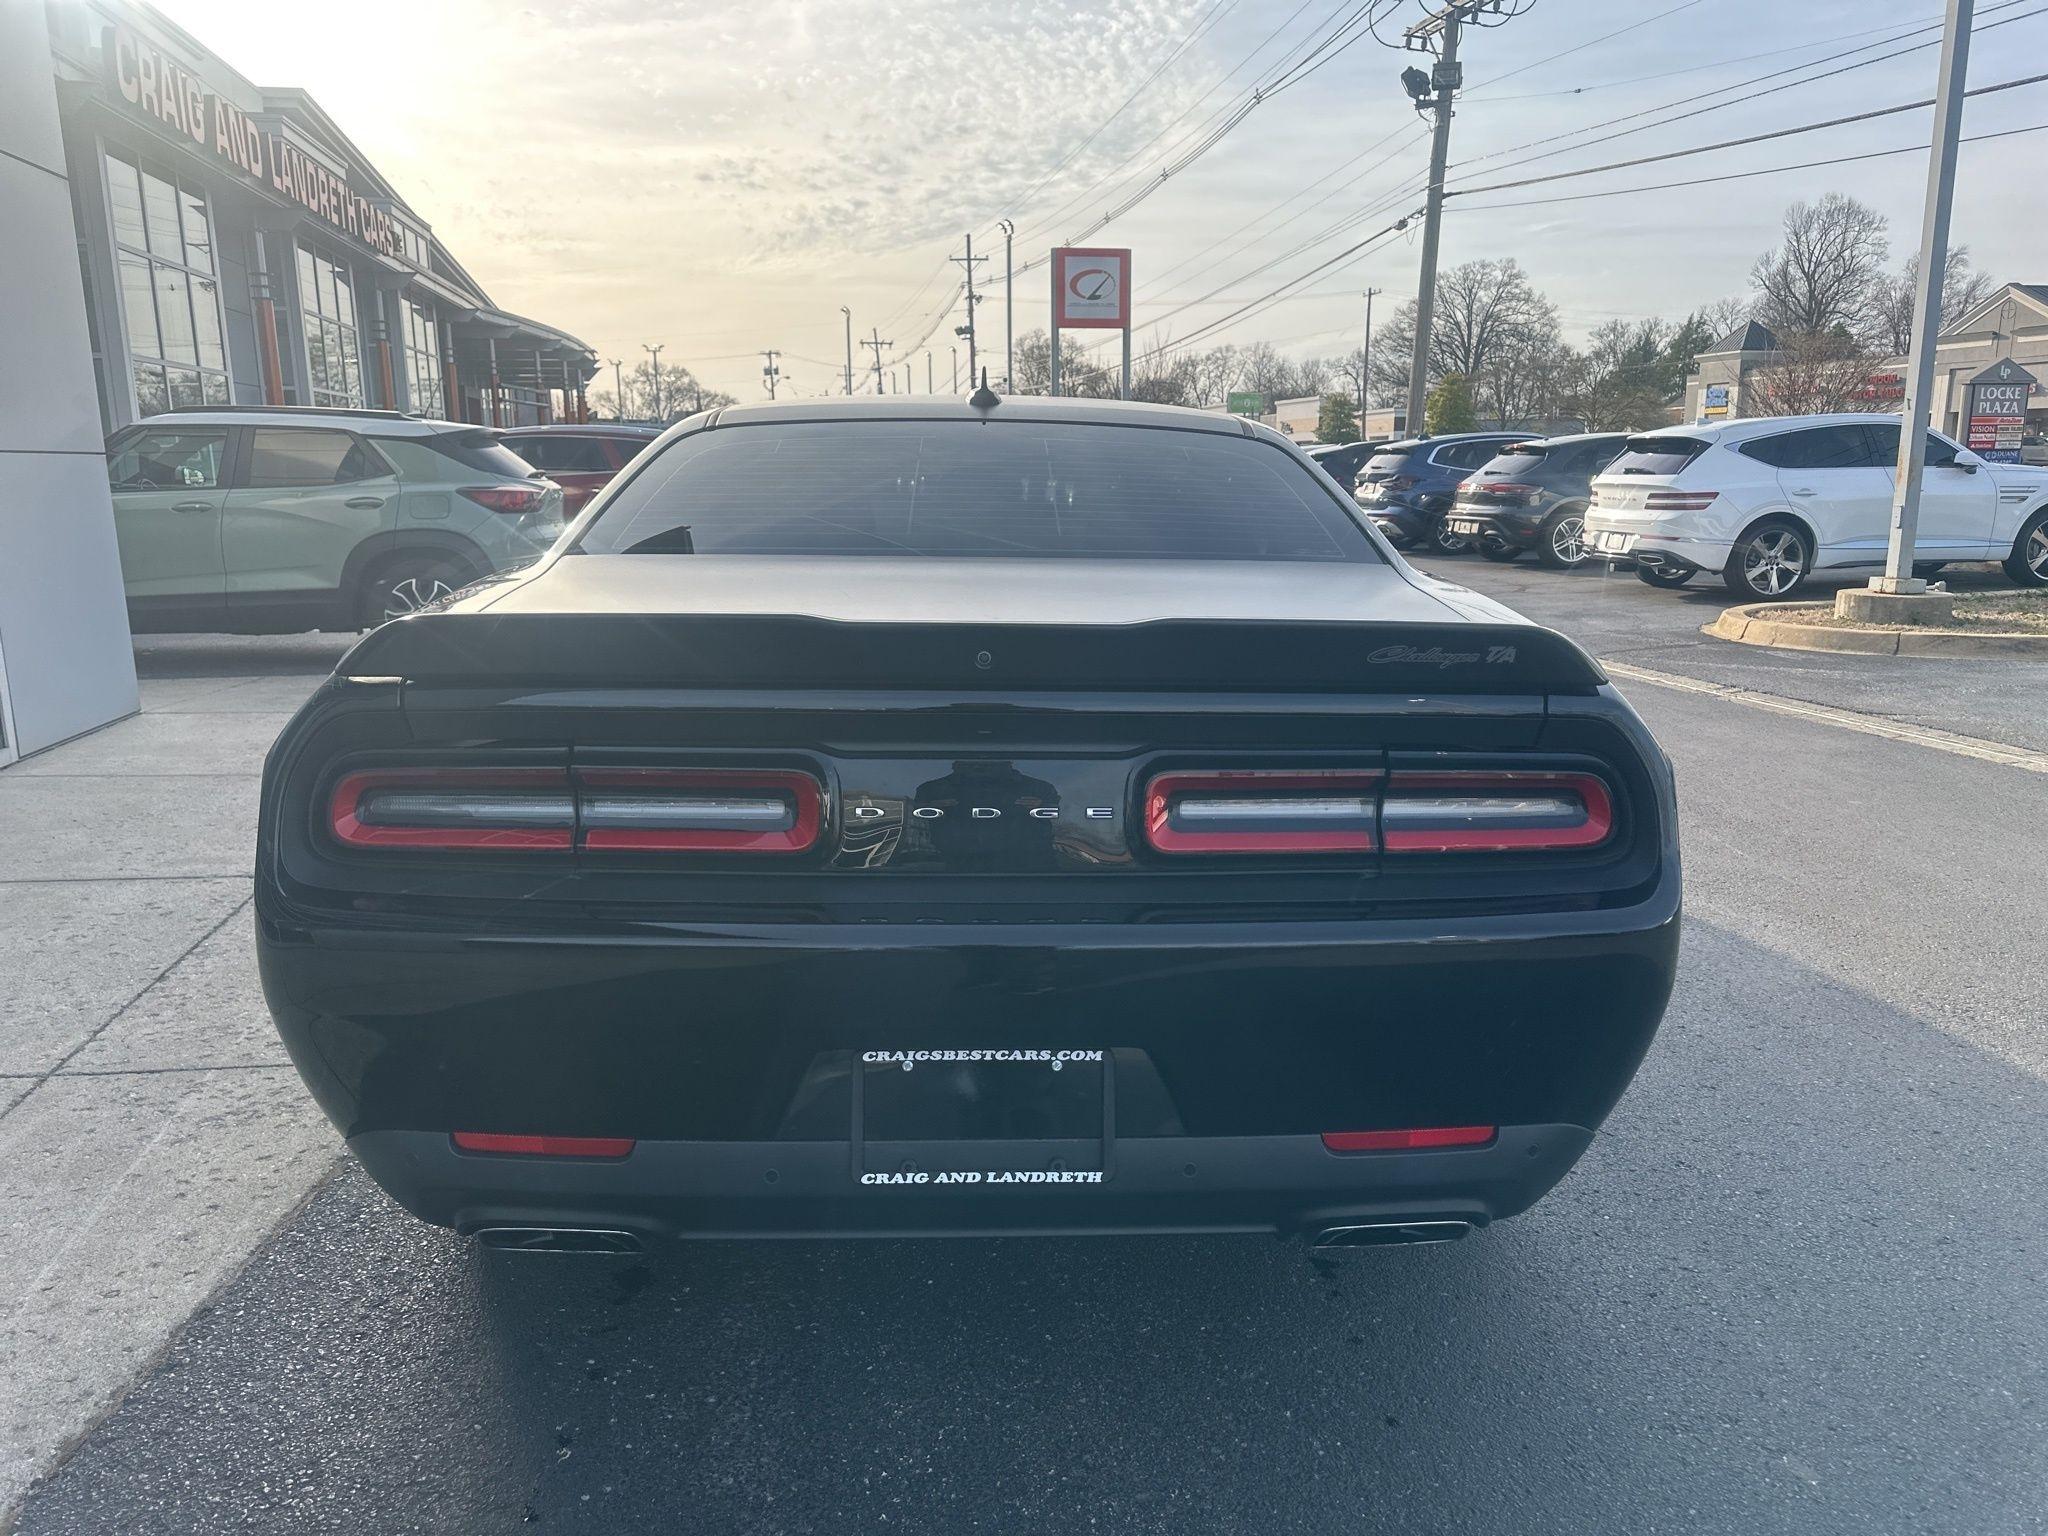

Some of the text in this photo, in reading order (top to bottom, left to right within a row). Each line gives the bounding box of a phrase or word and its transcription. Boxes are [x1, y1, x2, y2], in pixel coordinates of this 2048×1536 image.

[114, 22, 394, 257] CRAIG AND LANDRETH CARS
[1980, 387, 2021, 399] LOCKE
[1979, 401, 2018, 414] PLAZA
[1971, 425, 1995, 433] VISION
[855, 807, 1113, 819] DODGE
[862, 1050, 1104, 1062] CRAIGSBESTCARS.COM
[860, 1171, 1103, 1184] CRAIG AND LANDRETH
